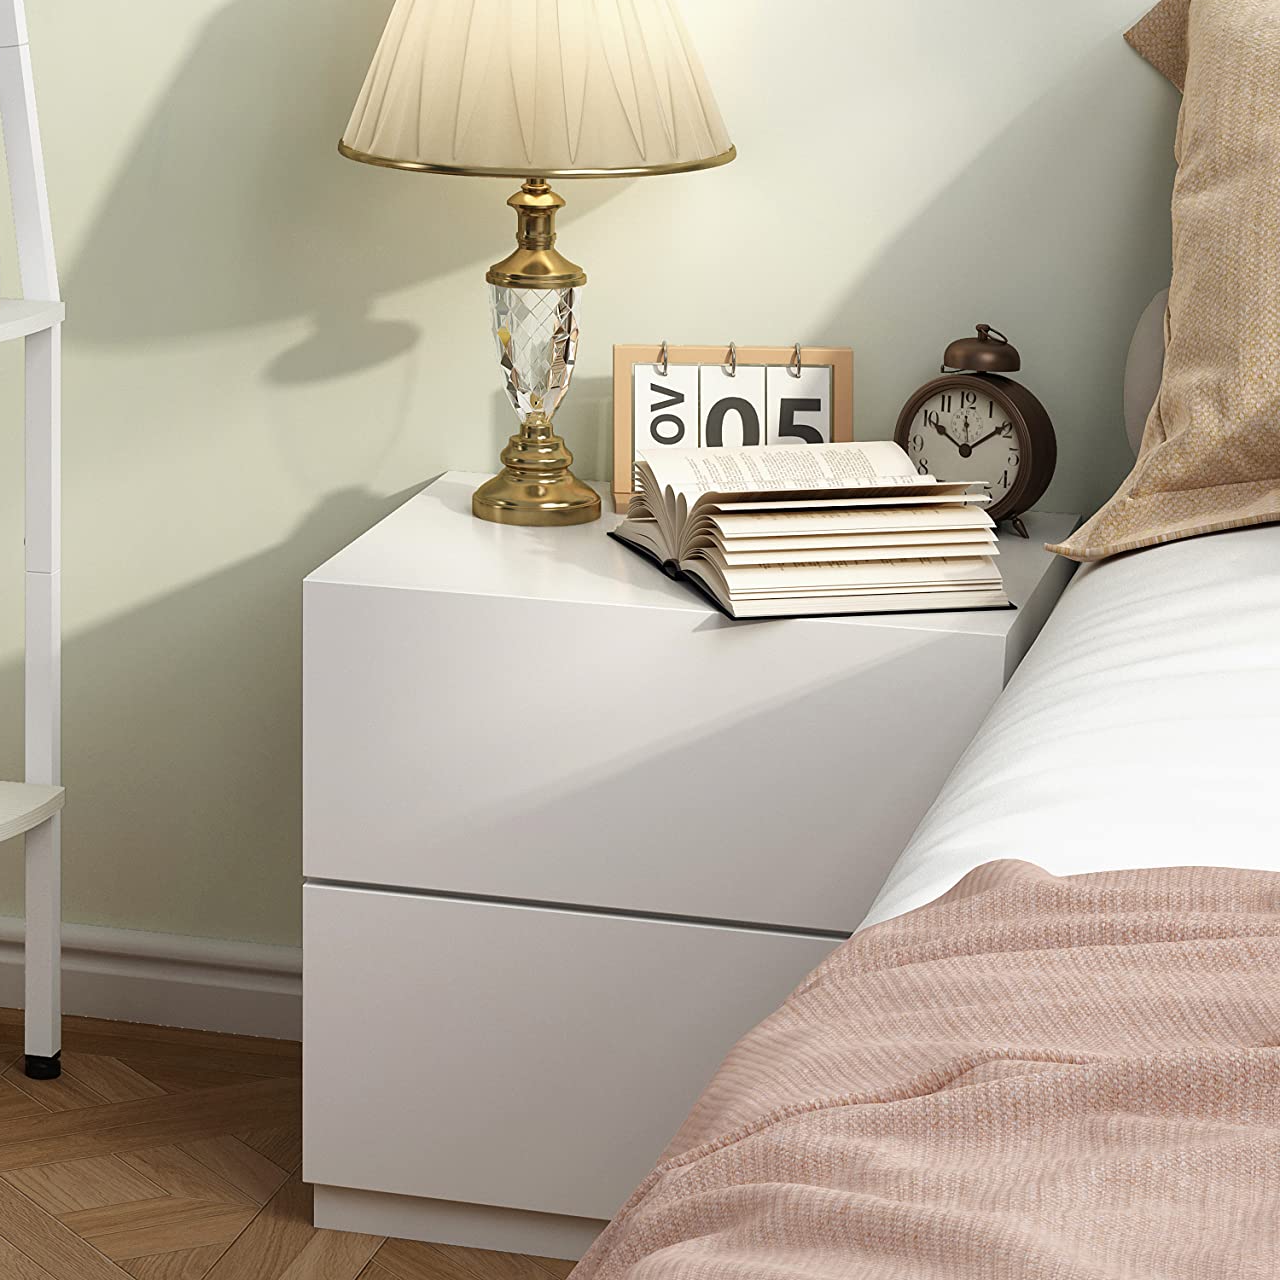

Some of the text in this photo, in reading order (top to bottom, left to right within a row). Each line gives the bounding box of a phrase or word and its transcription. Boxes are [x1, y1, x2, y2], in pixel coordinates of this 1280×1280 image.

[941, 394, 951, 413] 11
[960, 391, 976, 410] 12
[989, 401, 994, 418] 1
[650, 383, 685, 445] OV
[923, 409, 940, 427] 10
[913, 435, 924, 452] 9
[918, 458, 928, 475] 8
[997, 469, 1010, 488] 4
